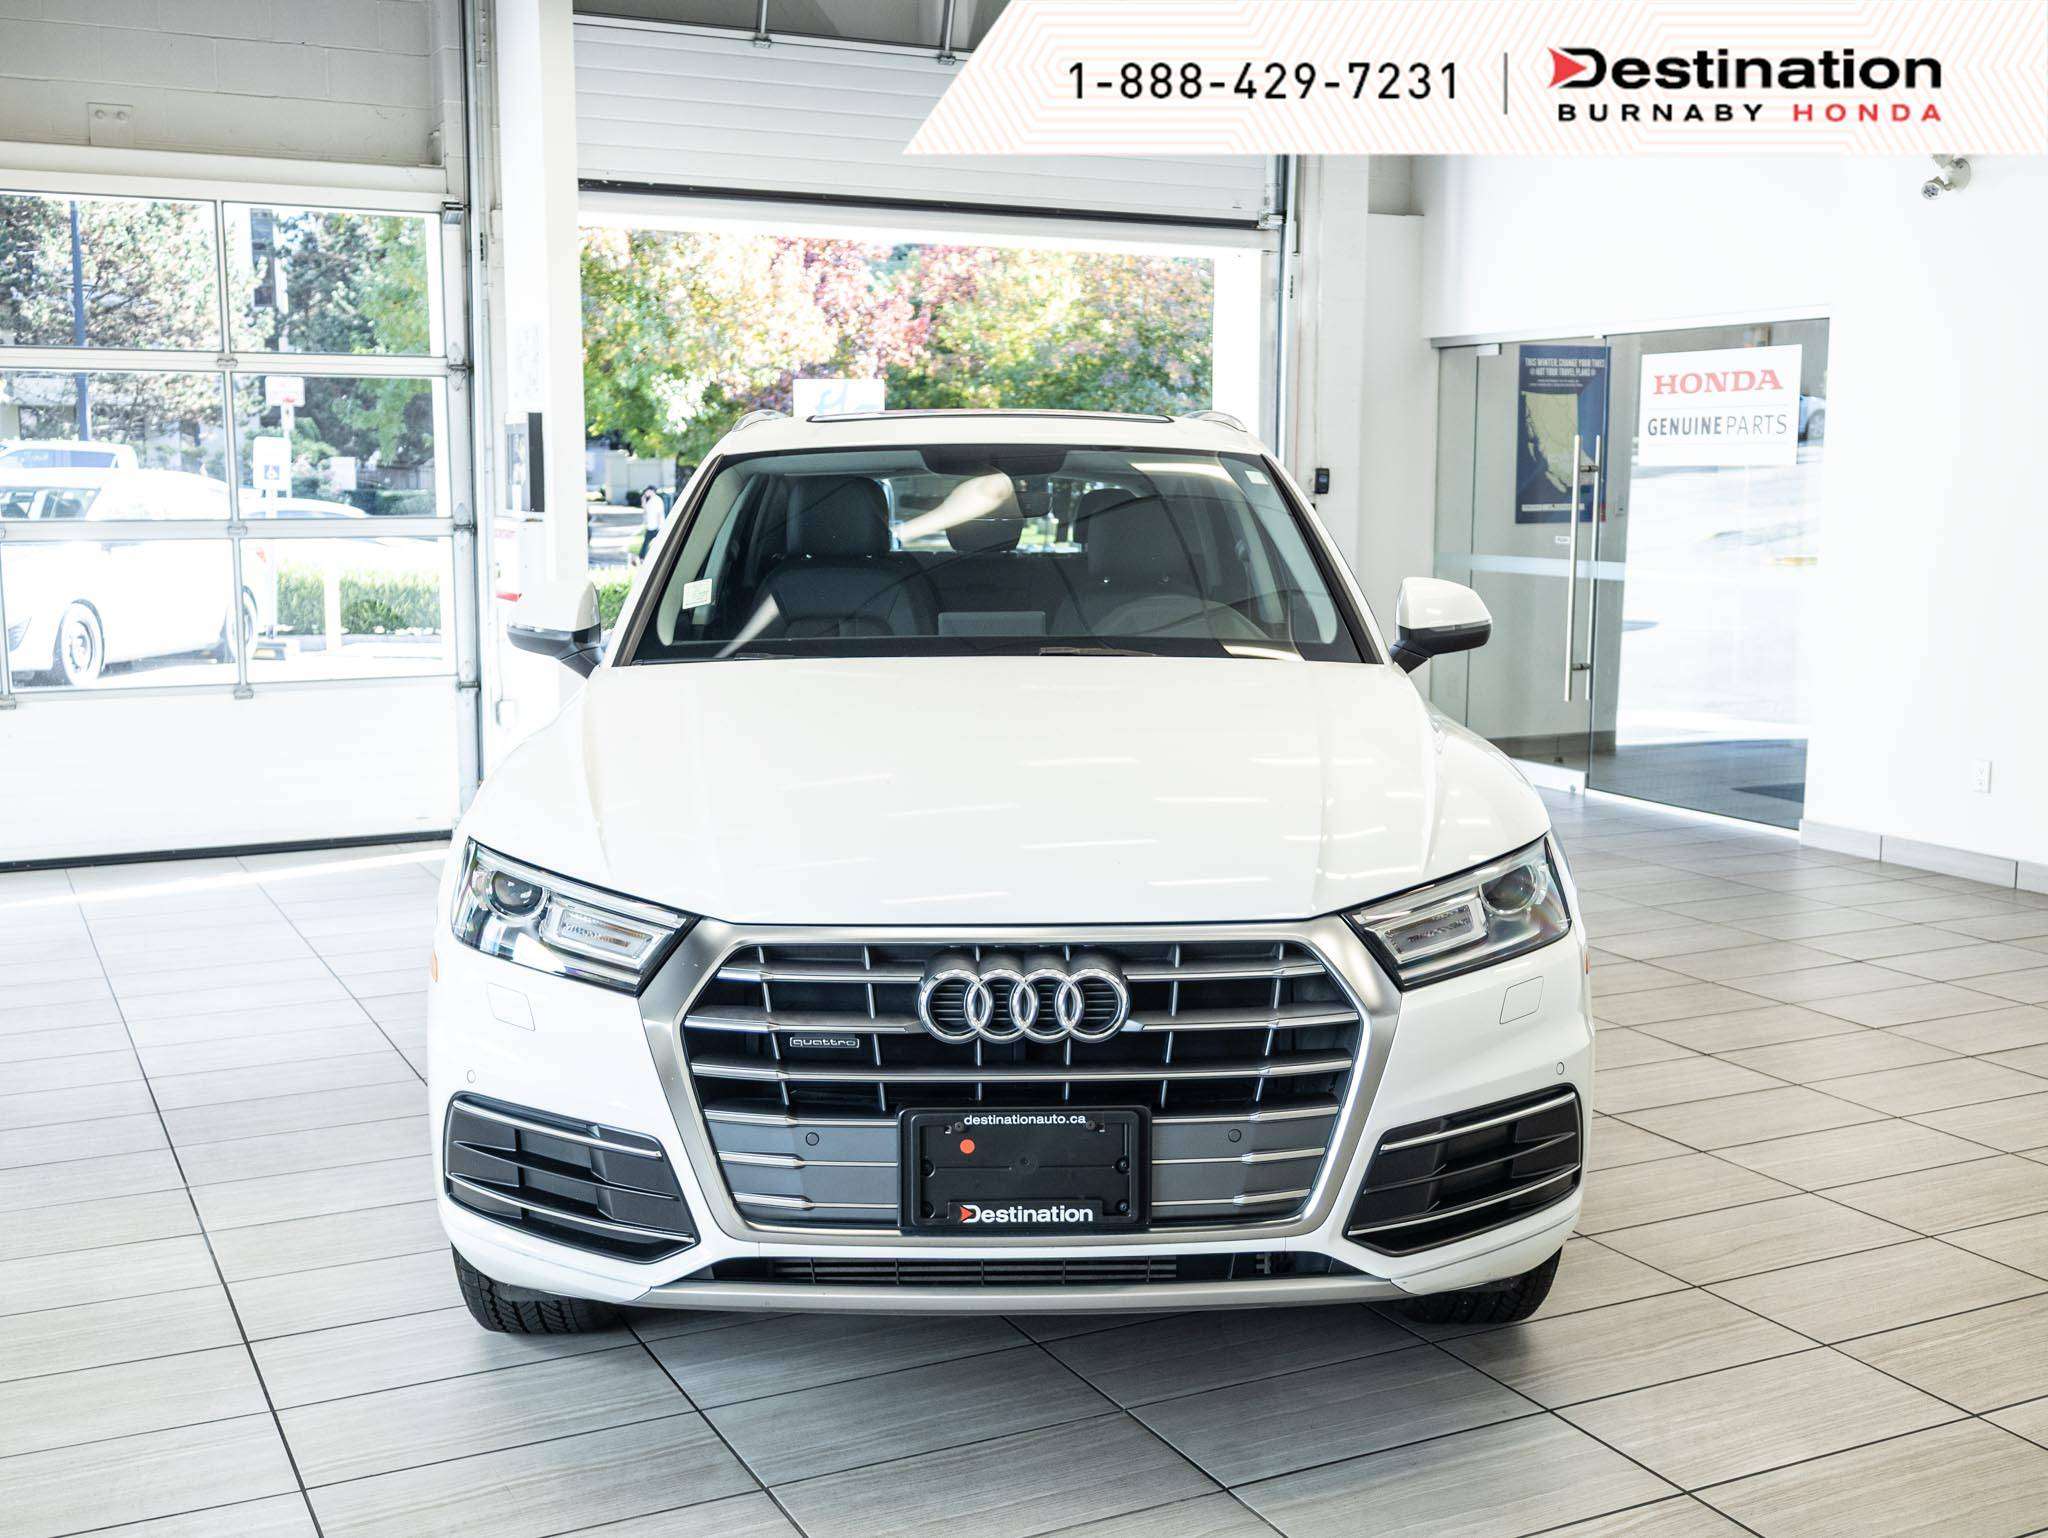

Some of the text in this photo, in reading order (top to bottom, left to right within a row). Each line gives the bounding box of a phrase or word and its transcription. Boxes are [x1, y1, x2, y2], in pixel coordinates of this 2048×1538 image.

[1653, 368, 1784, 395] HONDA
[1647, 414, 1787, 436] GENUINE PARTS
[792, 1038, 857, 1047] quattro
[963, 1114, 1087, 1125] destinationauto.ca
[960, 1204, 1094, 1224] Destination
